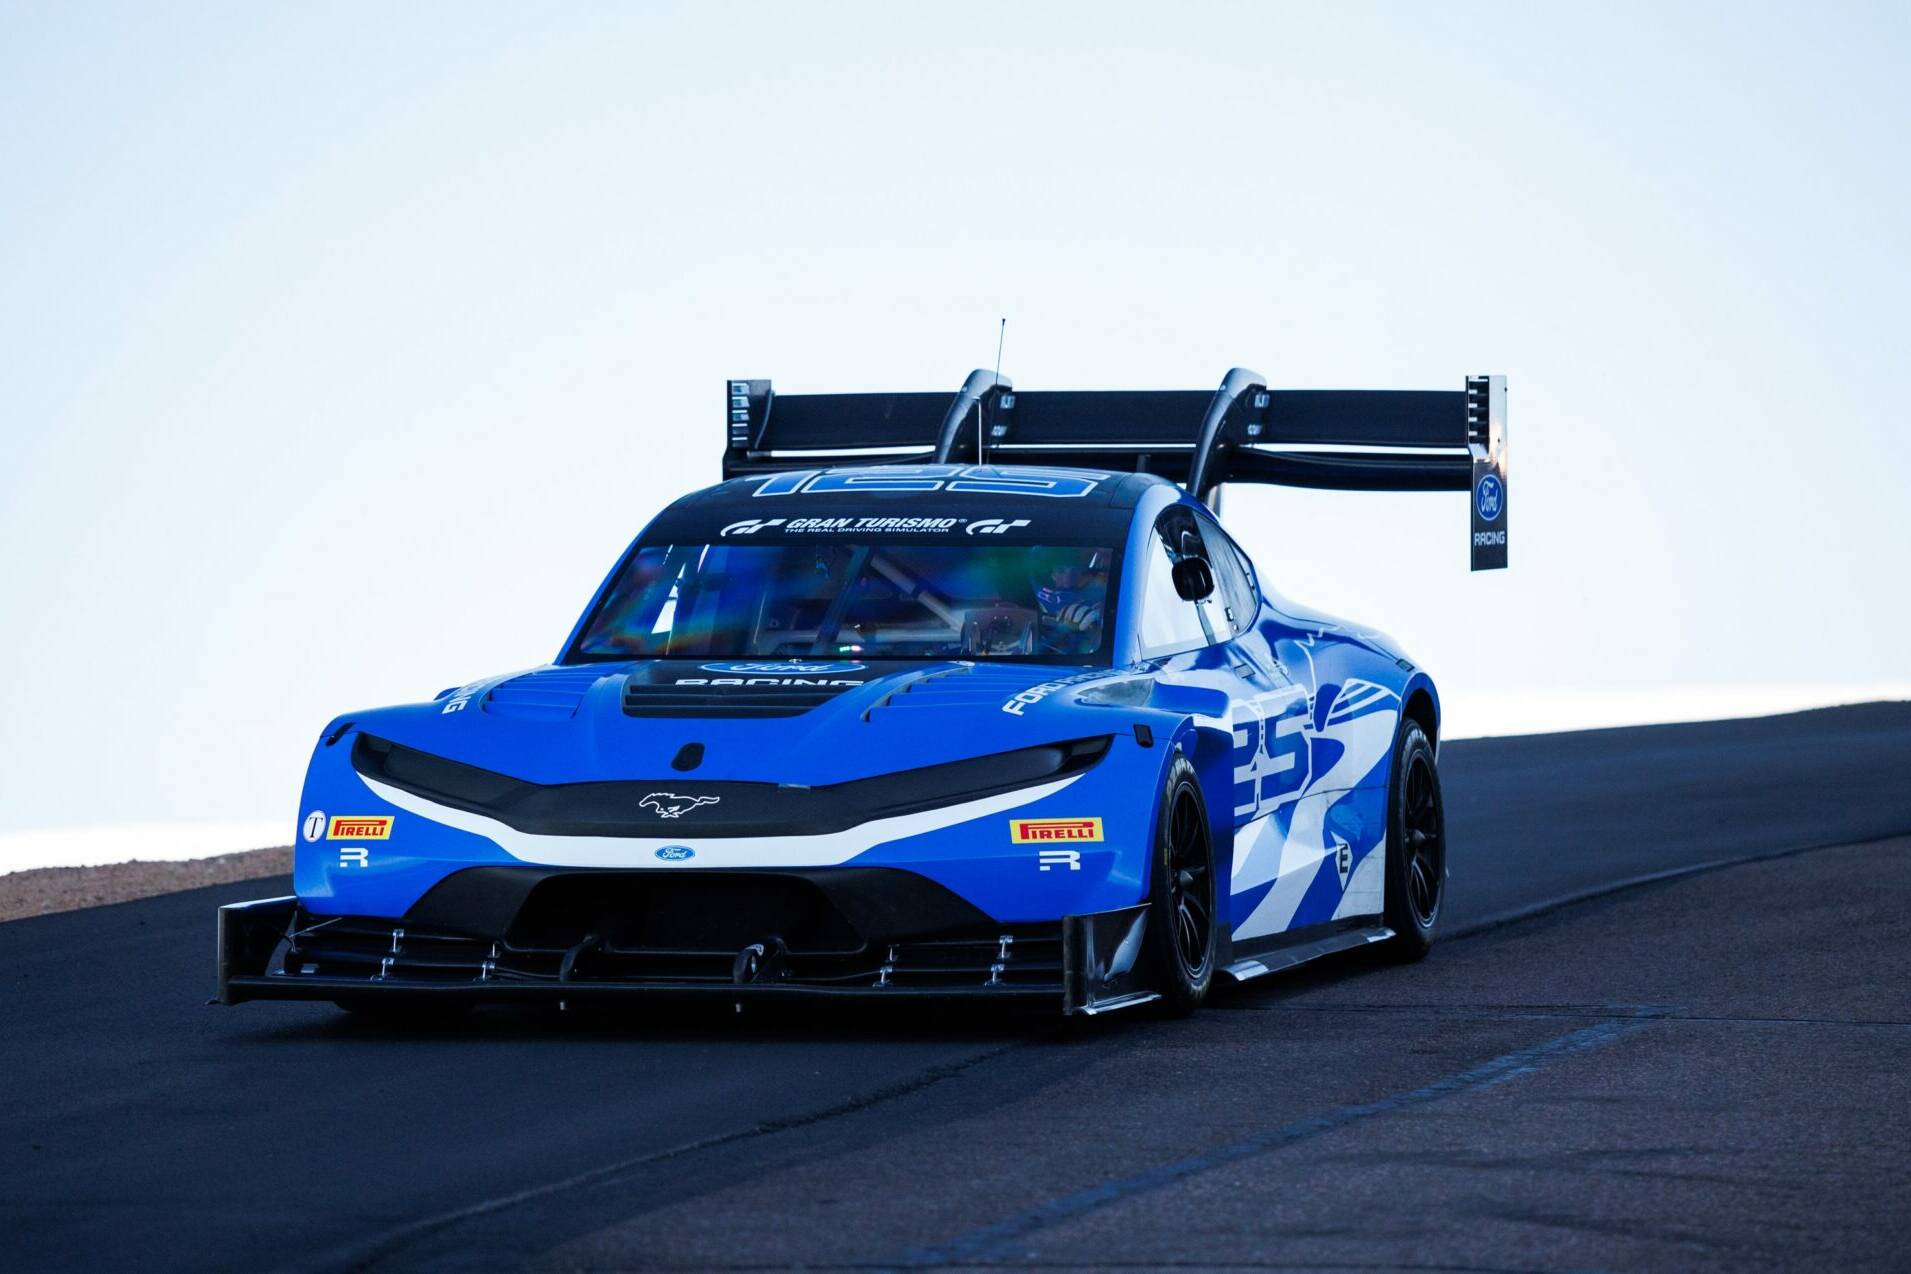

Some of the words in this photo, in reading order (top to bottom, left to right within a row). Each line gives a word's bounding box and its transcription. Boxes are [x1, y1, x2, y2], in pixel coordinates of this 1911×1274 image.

[745, 464, 1111, 498] 125
[786, 518, 854, 529] GRAN
[1474, 531, 1506, 546] RACING
[675, 678, 865, 687] RACING
[1002, 680, 1066, 716] FORD
[309, 816, 324, 838] T
[333, 819, 388, 837] PIRELLI
[1019, 821, 1095, 840] PIRELLI
